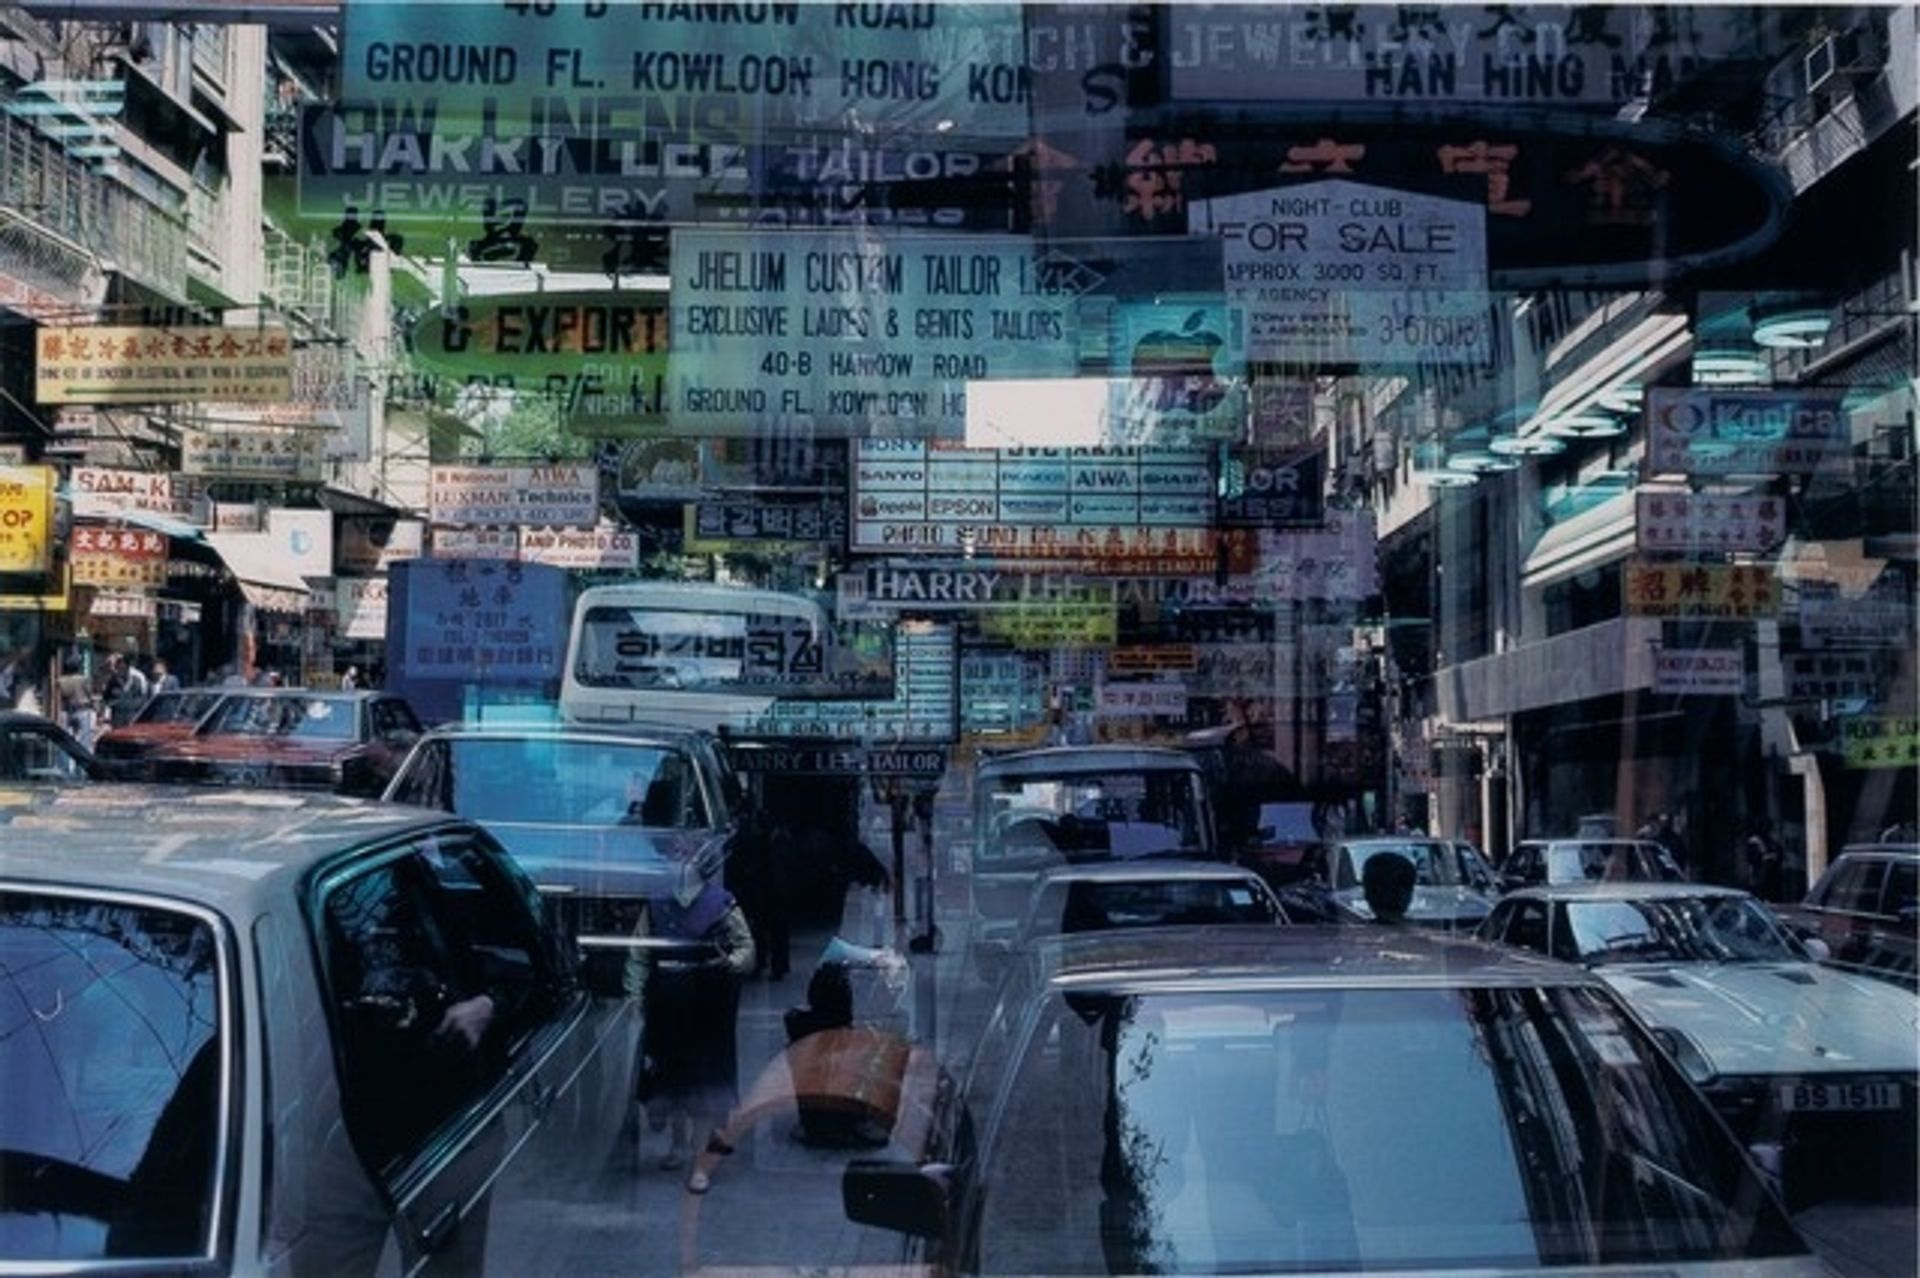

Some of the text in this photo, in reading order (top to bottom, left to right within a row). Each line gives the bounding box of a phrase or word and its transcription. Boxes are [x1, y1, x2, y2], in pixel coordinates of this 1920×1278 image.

[365, 42, 518, 84] GROUND
[546, 48, 606, 89] FL.
[632, 50, 813, 97] KOWLOON
[840, 59, 939, 101] HONG
[1366, 51, 1456, 97] HAN
[331, 127, 982, 182] HARRY LEE TAILOR
[343, 181, 669, 215] JEWELLERY
[1218, 221, 1457, 254] FOR SALE
[689, 251, 786, 293] JHELUM
[805, 252, 904, 296] CUSTOM
[922, 254, 1001, 296] TAILOR
[495, 303, 665, 355] EXPORT
[687, 305, 789, 337] EXCLUSIVE
[885, 305, 900, 339] &
[915, 307, 974, 340] GENTS
[991, 308, 1064, 341] TAILORS
[932, 353, 989, 380] ROAD
[686, 386, 767, 413] GROUND
[530, 466, 581, 483] AIWA
[859, 470, 923, 482] SANYO
[1074, 470, 1133, 487] AIWA
[516, 489, 592, 504] Technics
[930, 499, 994, 516] EPSON
[873, 570, 1001, 601] HARRY
[871, 752, 942, 770] TAILOR
[1793, 1084, 1889, 1109] BS 1511
